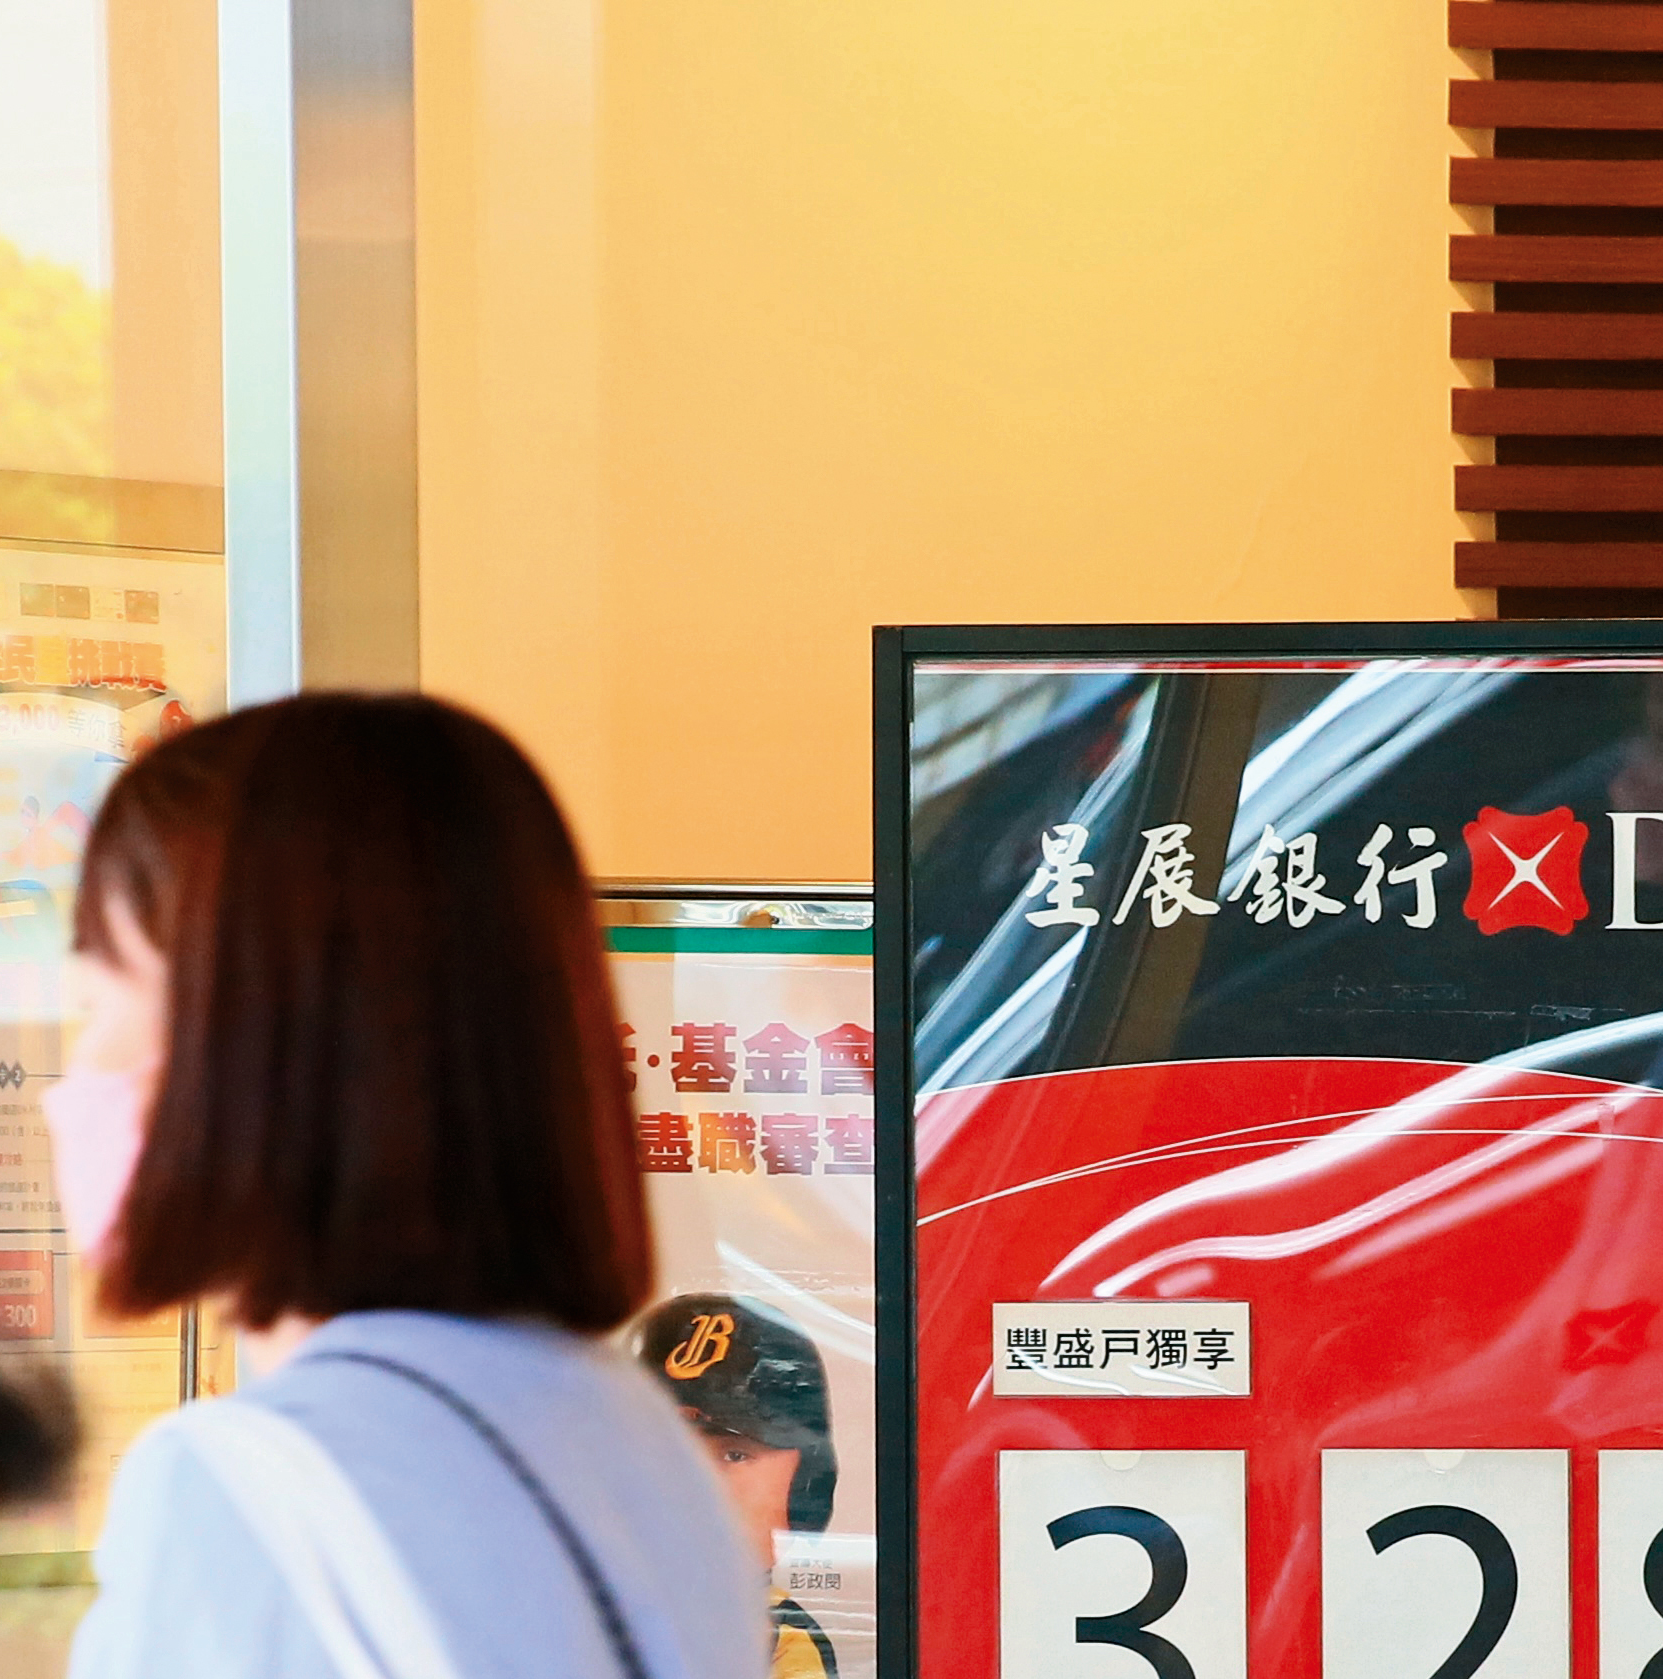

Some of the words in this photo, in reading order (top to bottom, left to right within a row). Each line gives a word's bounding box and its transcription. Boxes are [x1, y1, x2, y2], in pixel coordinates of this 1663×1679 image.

[1024, 822, 1449, 931] 星展銀行
[616, 1022, 876, 1095] ·基金會
[4, 1304, 37, 1328] 300
